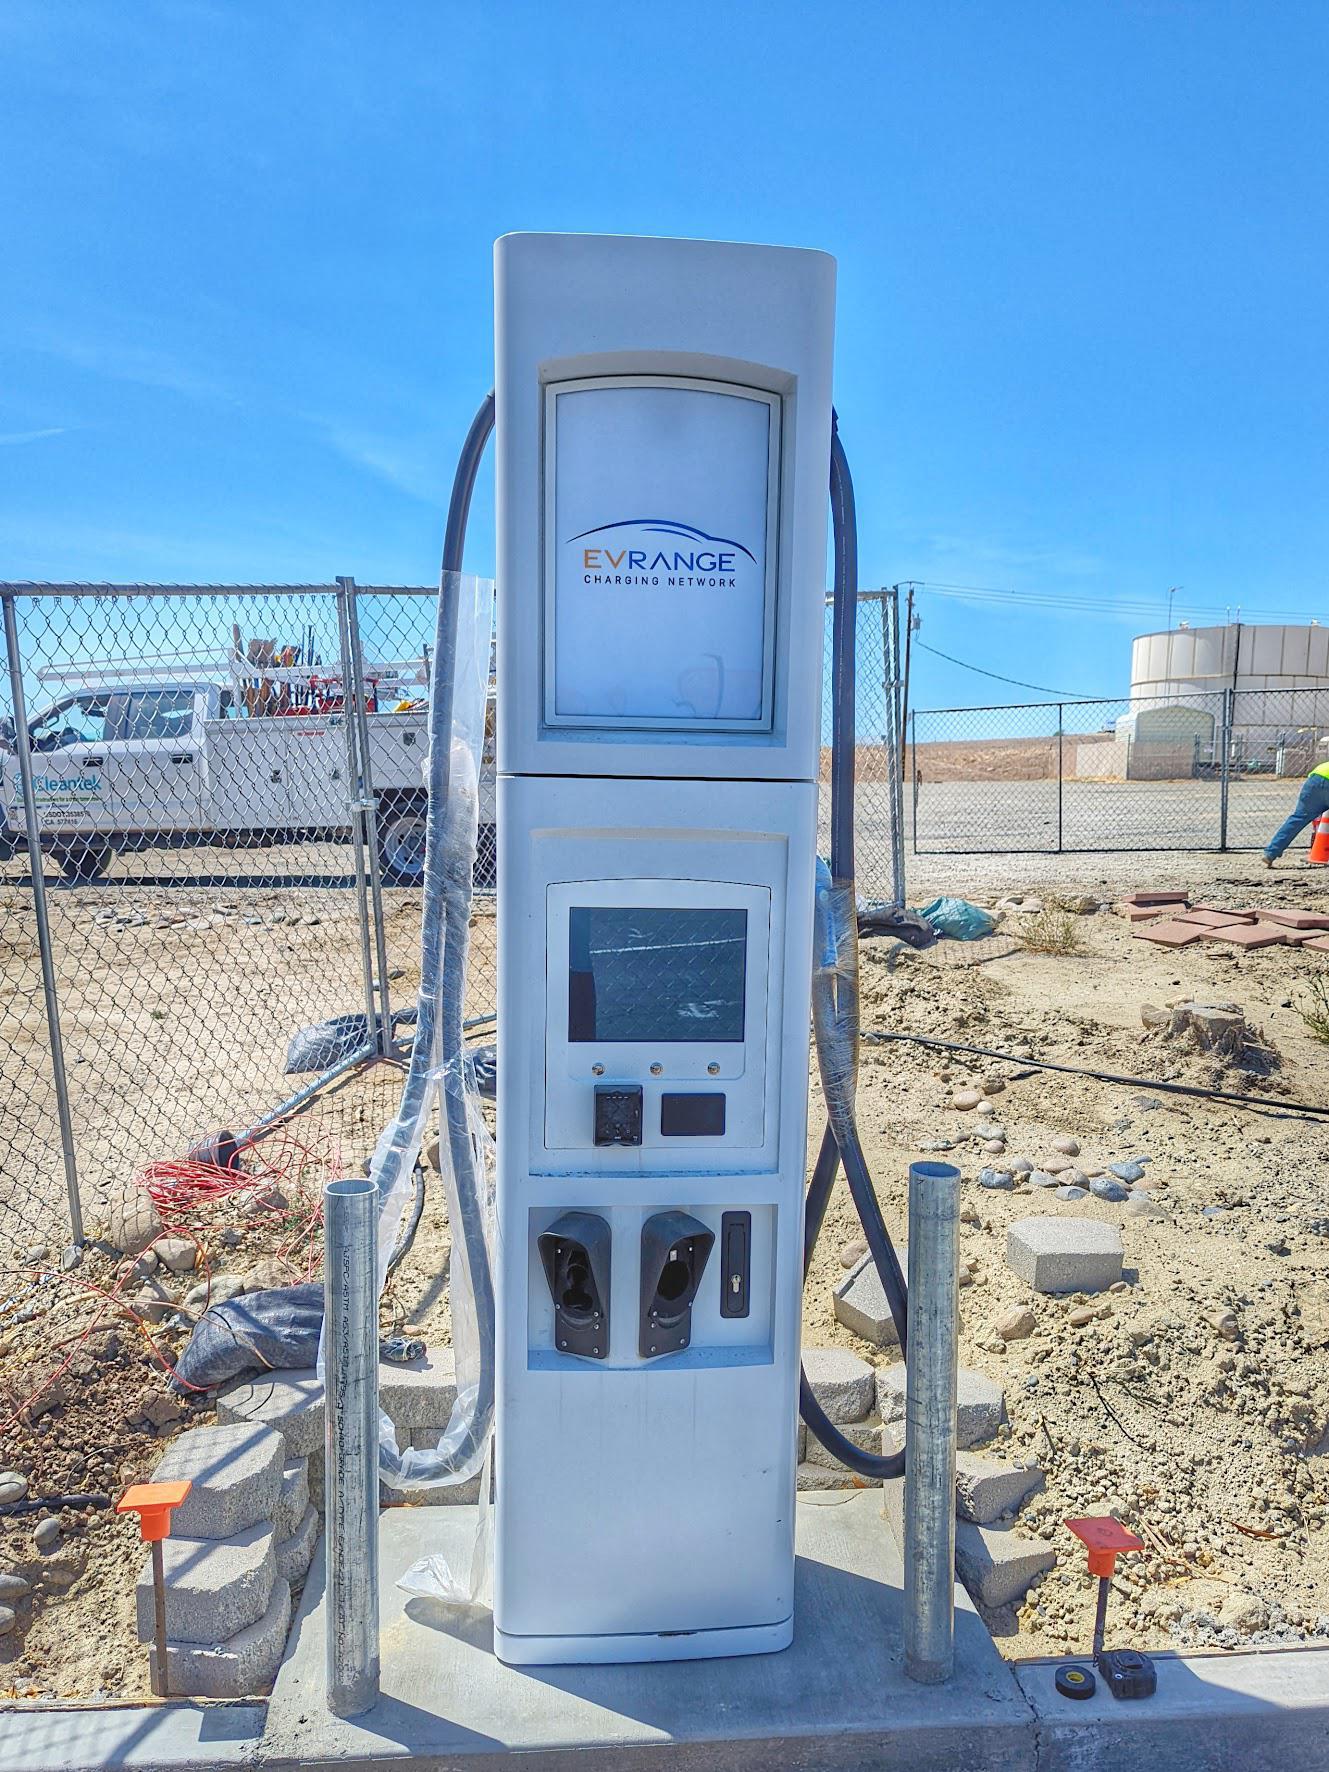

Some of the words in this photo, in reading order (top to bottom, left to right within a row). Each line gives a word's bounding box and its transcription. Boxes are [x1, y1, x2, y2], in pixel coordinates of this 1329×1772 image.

[584, 549, 736, 572] EVRANGE
[584, 574, 659, 586] CHARGING
[668, 577, 736, 588] NETWORK
